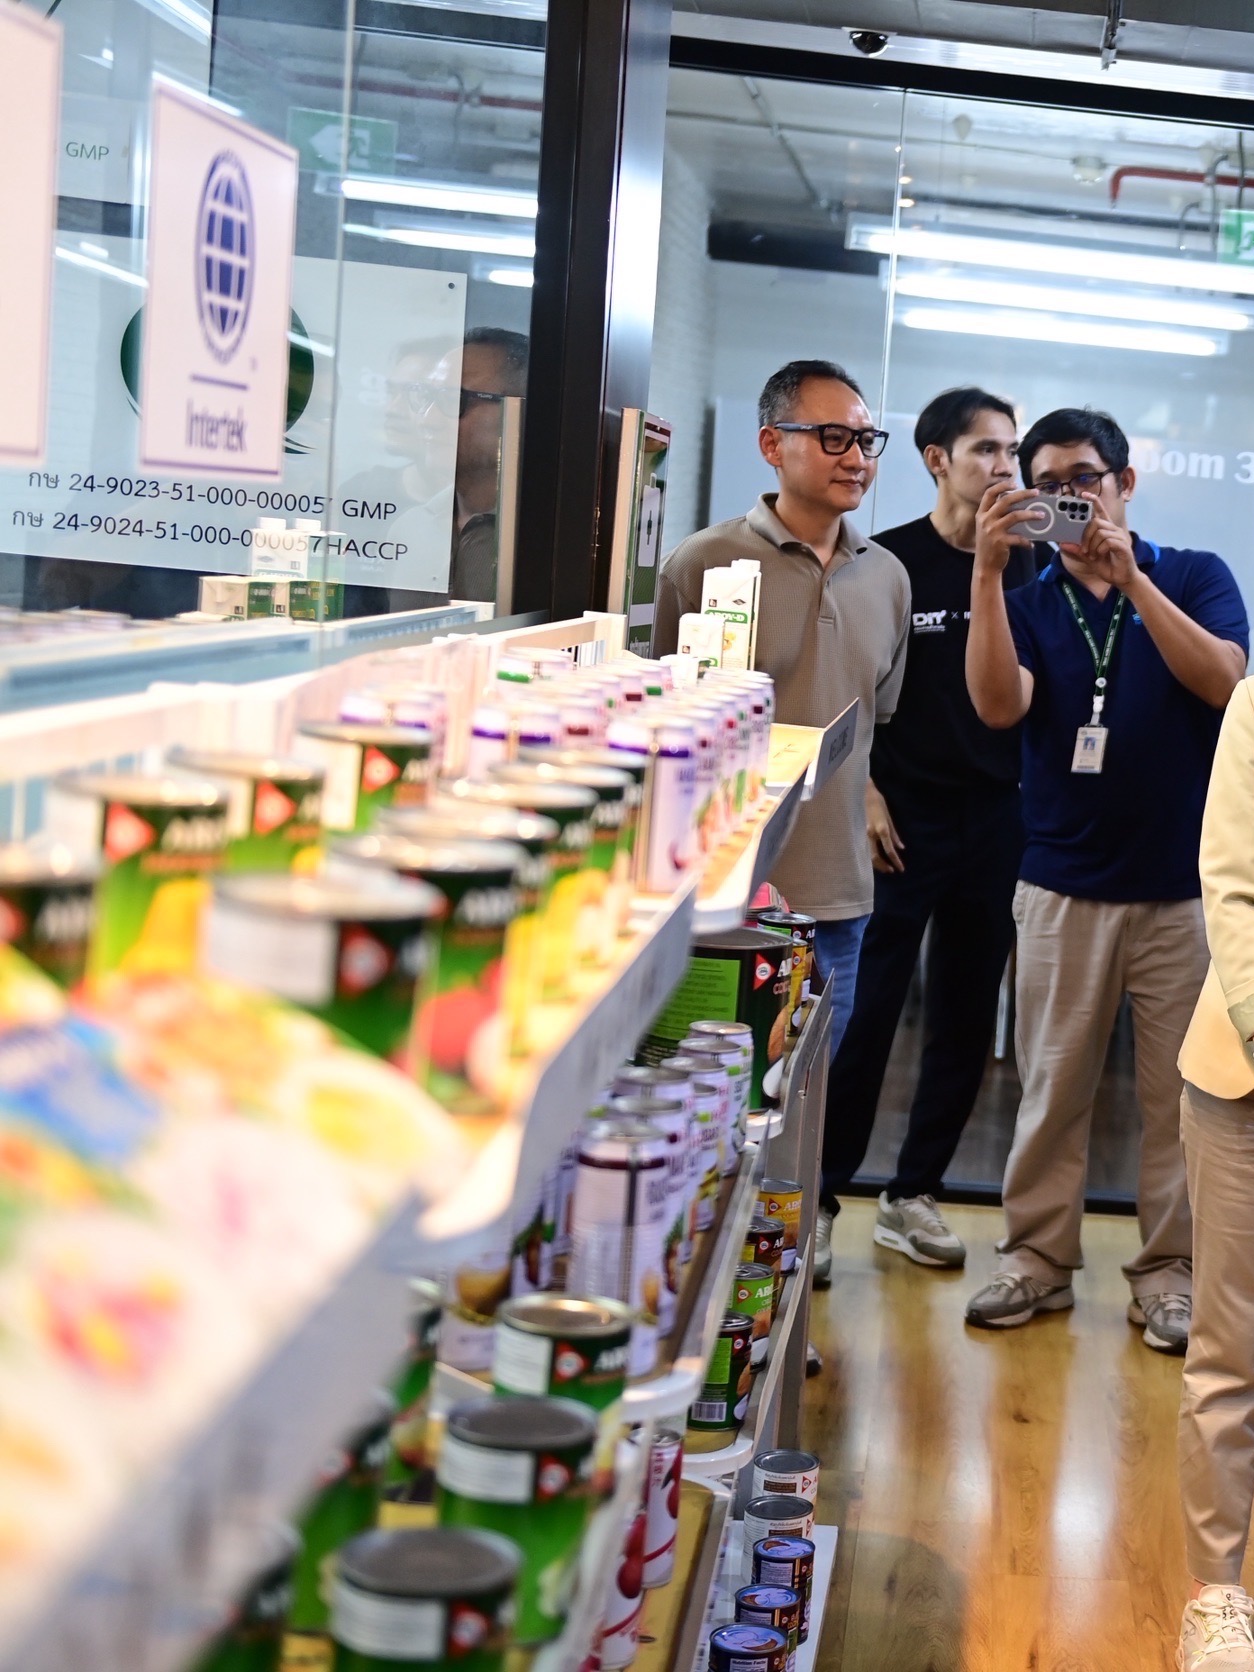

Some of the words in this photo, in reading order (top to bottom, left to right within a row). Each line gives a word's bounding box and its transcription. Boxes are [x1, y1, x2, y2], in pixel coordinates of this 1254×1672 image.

[66, 142, 109, 160] GMP
[1136, 449, 1225, 480] oom
[28, 472, 60, 489] กษ
[68, 473, 333, 514] 24-9023-51-000-00005
[342, 499, 397, 520] GMP
[12, 510, 44, 528] กษ
[327, 537, 408, 561] HACCP
